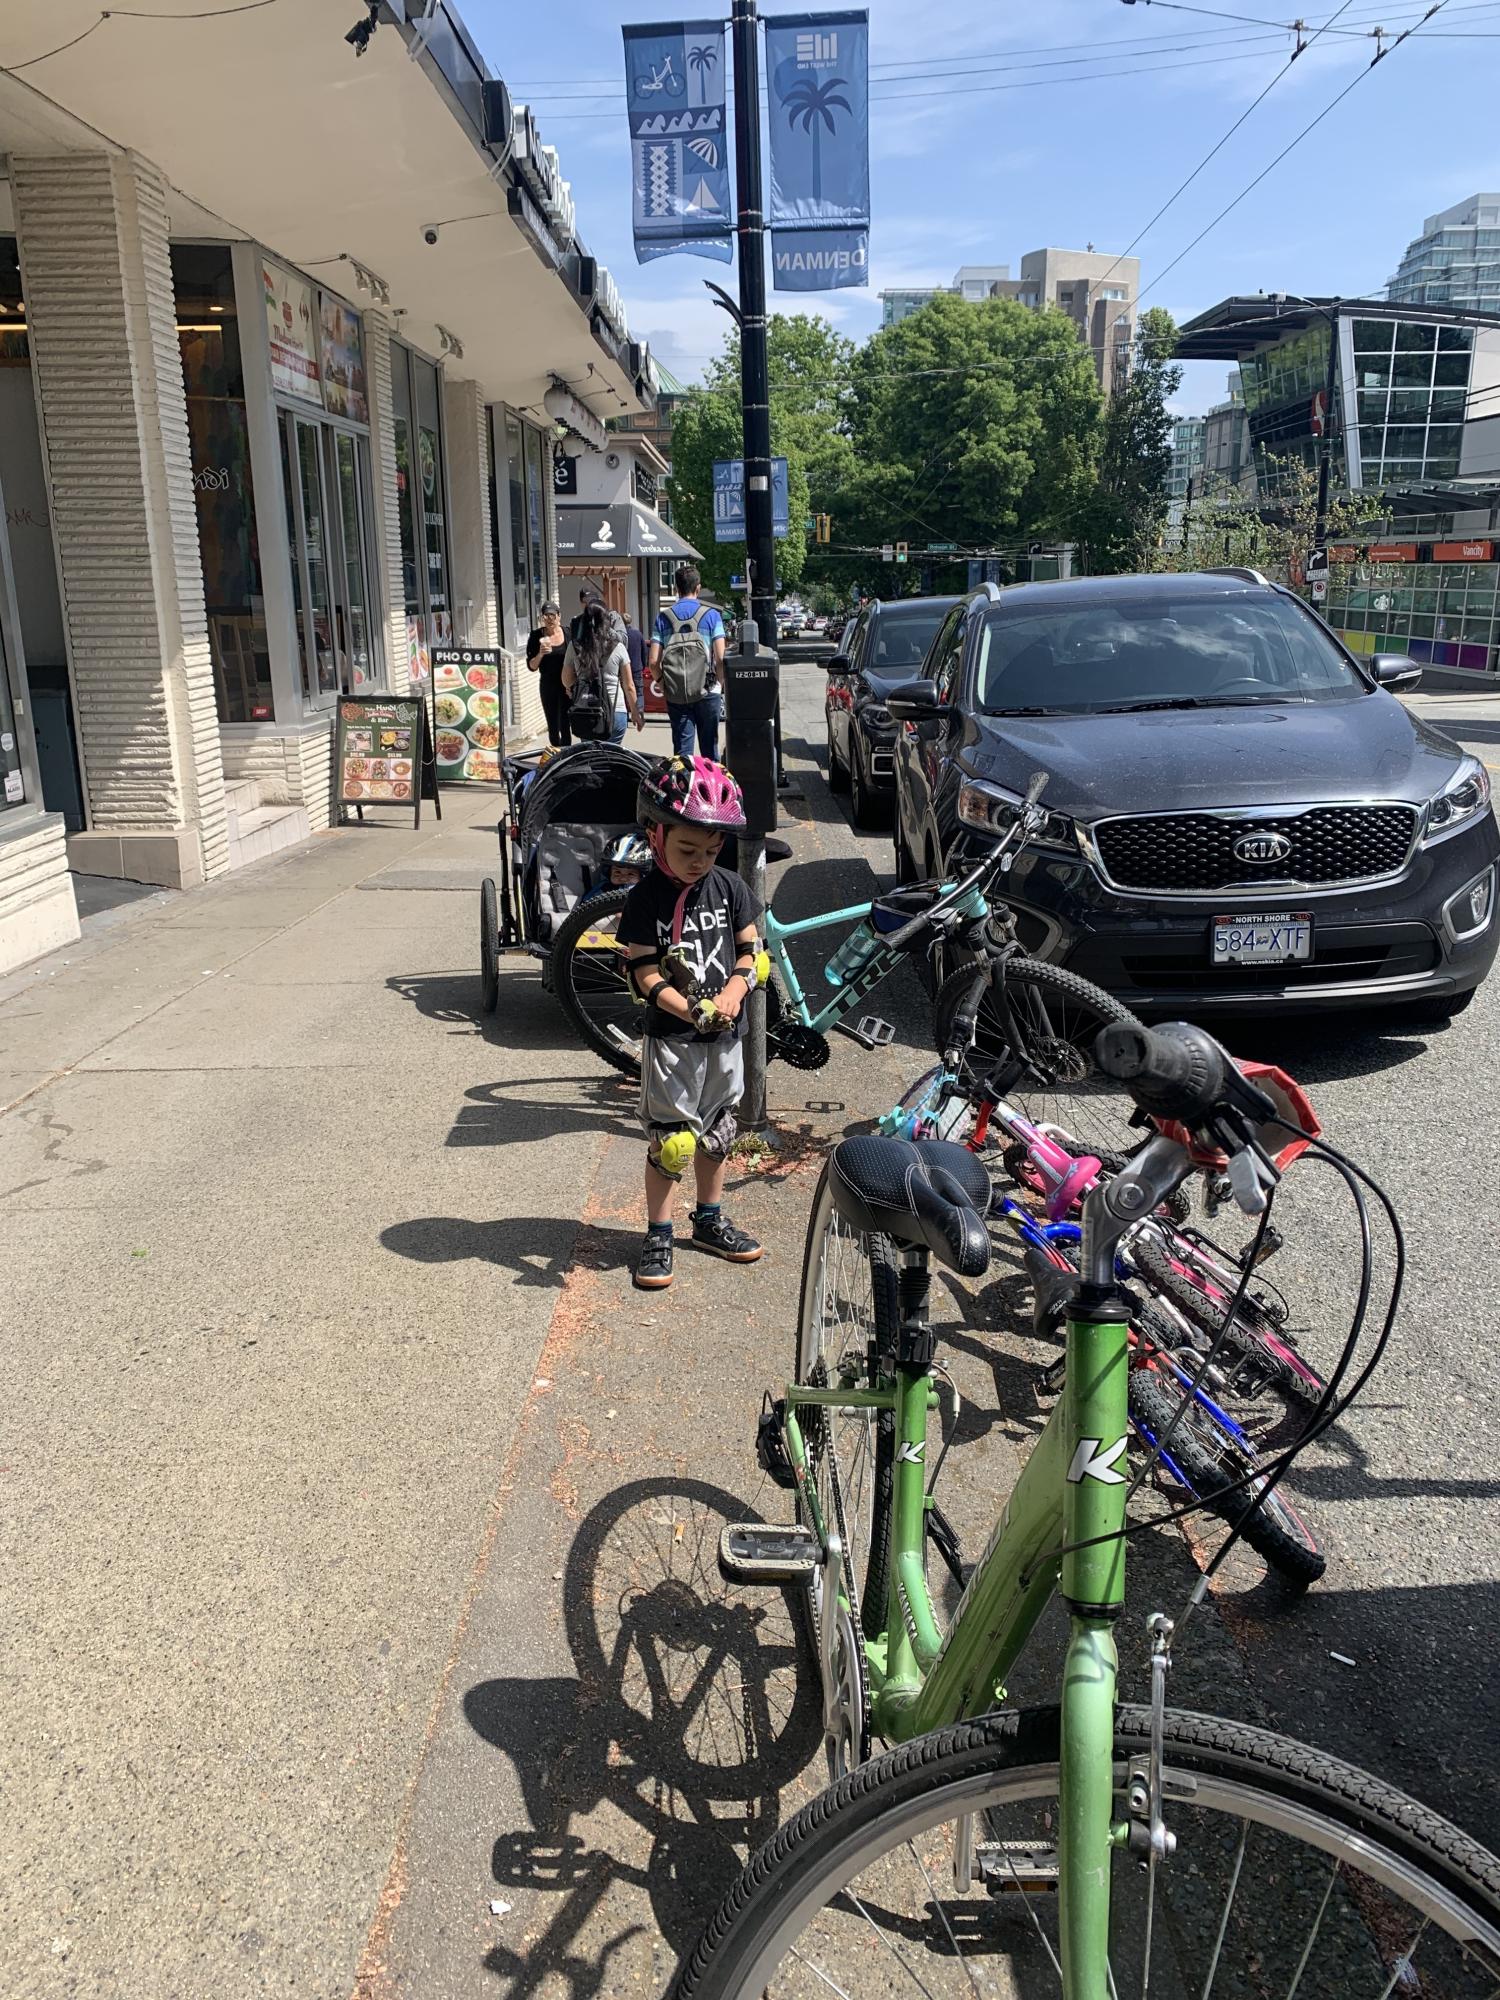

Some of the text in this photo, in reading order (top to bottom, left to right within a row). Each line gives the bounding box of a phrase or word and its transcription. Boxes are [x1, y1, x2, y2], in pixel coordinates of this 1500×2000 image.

[193, 466, 229, 490] ndi
[638, 545, 673, 553] breka.ca
[1463, 545, 1484, 558] Vancity
[436, 651, 495, 662] PHO Q & M
[1244, 841, 1282, 859] KIA
[656, 908, 728, 936] MADE
[1235, 916, 1263, 924] NORTH
[1264, 914, 1291, 923] SHORE
[659, 937, 672, 946] IN
[1215, 927, 1309, 952] 584 XTF
[828, 949, 909, 1015] TRE
[1066, 1434, 1129, 1485] K
